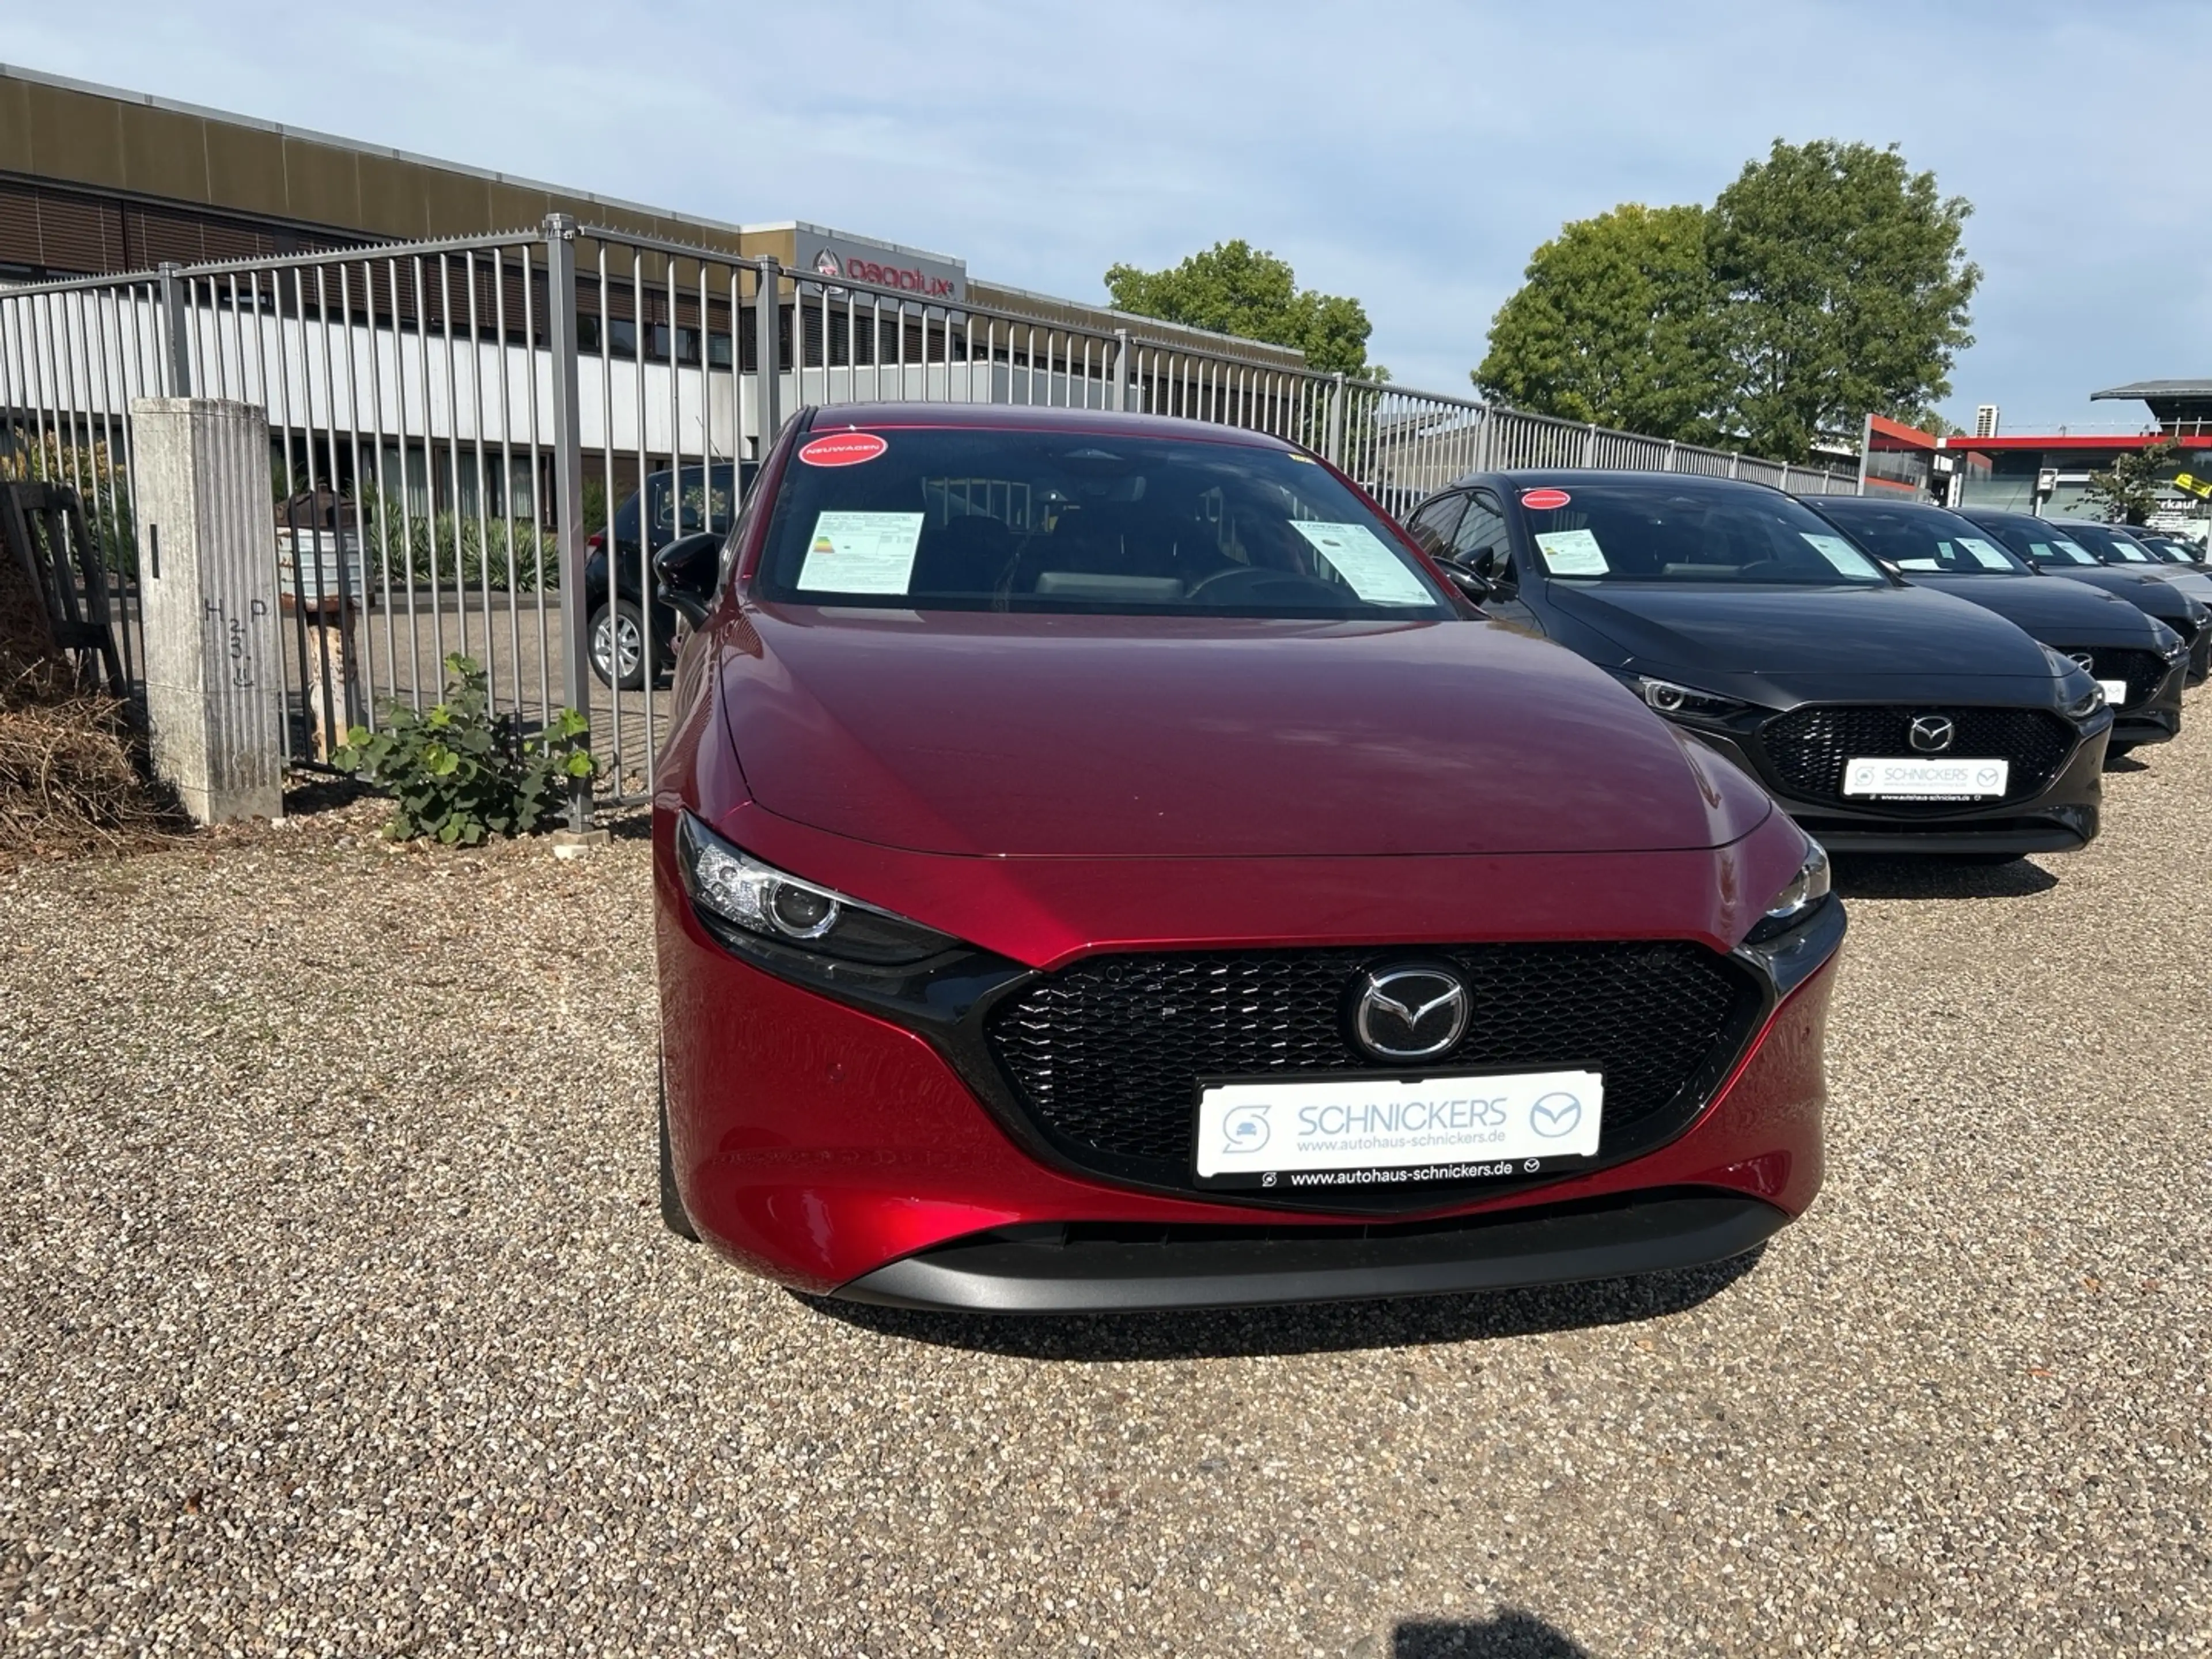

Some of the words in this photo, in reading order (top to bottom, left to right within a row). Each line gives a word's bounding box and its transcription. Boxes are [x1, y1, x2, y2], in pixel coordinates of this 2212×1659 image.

[806, 445, 880, 454] NEUWAGEN
[1884, 767, 1969, 781] SCHNICKERS
[1298, 1097, 1508, 1135] SCHNICKERS
[1297, 1130, 1506, 1152] www.autohaus-schnickers.de
[1291, 1161, 1513, 1185] www.autohaus-schnickers.de
